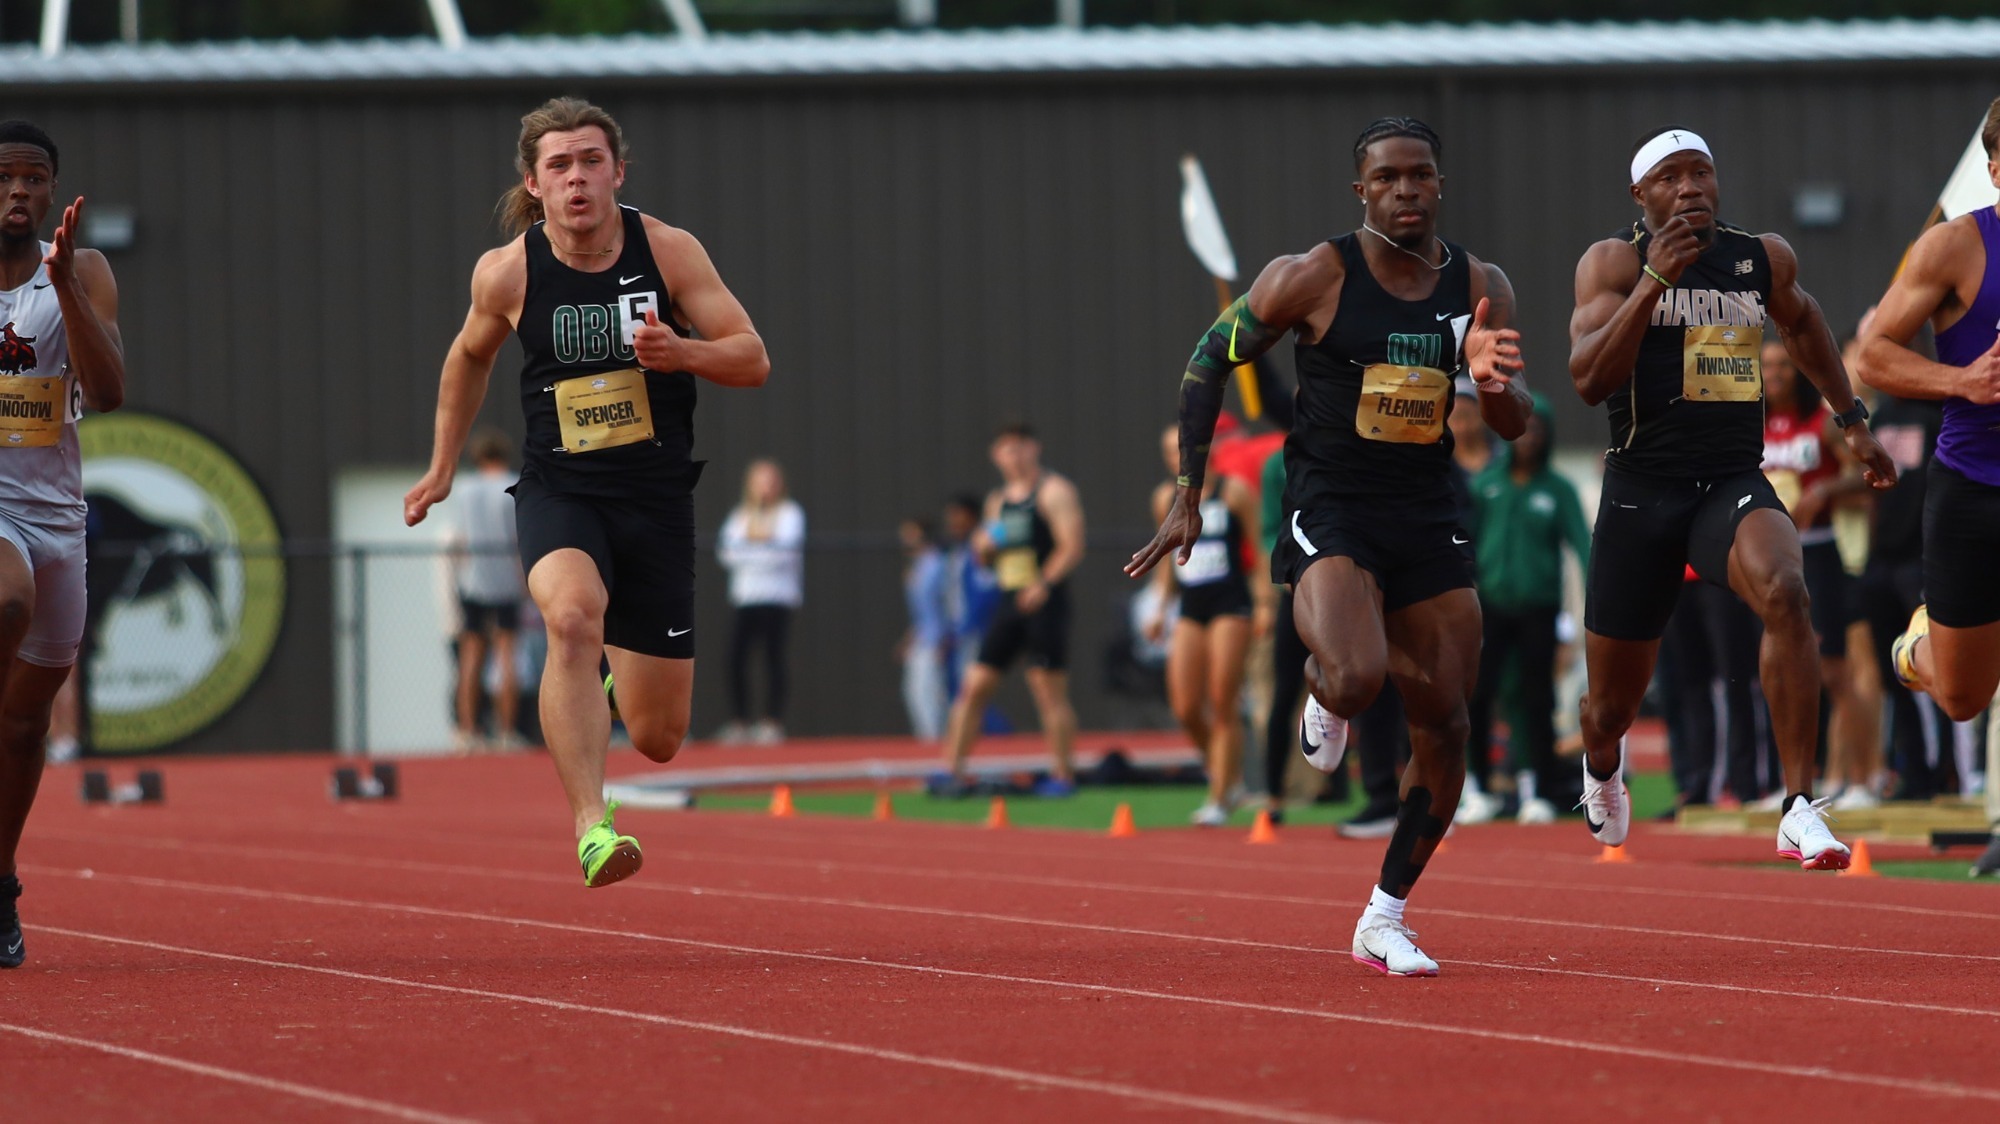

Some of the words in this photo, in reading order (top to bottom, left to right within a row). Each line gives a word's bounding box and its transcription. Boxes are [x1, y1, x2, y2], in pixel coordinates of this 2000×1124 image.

[1651, 288, 1766, 327] HARDING
[1388, 333, 1441, 367] OBU
[1697, 357, 1754, 376] NWAMERE
[0, 400, 52, 418] MADON
[575, 400, 635, 427] SPENCER
[1377, 396, 1435, 419] FLEMING
